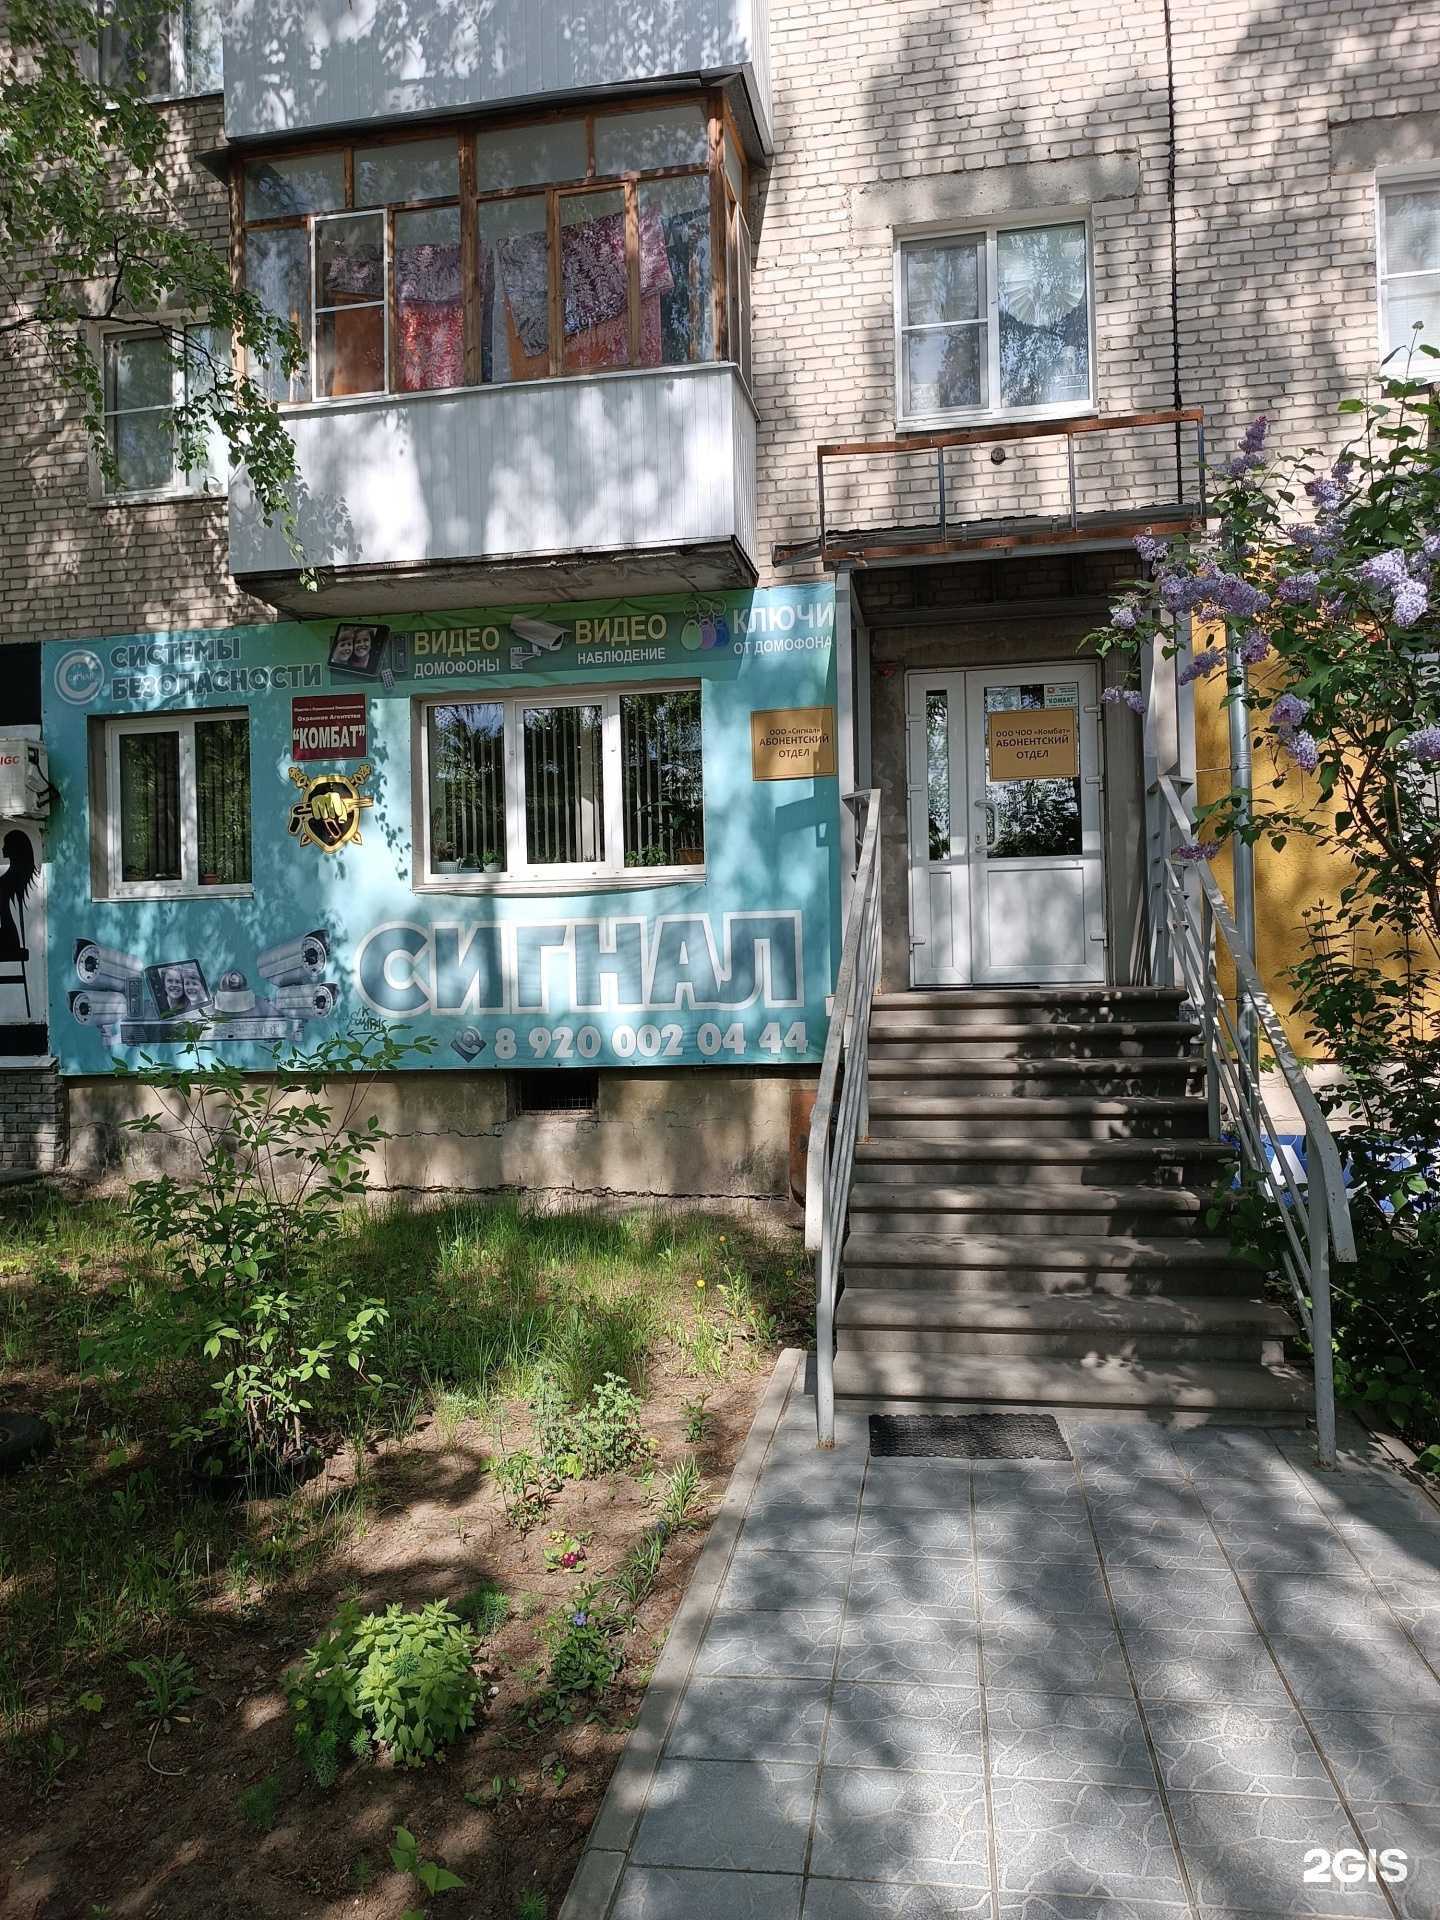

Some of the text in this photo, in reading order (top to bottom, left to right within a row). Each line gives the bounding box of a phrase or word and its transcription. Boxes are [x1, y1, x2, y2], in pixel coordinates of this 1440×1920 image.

[733, 602, 834, 634] КЛЮЧИ
[575, 614, 667, 647] ВИДЕО
[414, 626, 500, 657] ВИДЕО
[734, 636, 832, 656] ОТ ДОМОФОНА
[110, 637, 241, 669] СИСТЕМЫ
[577, 647, 667, 665] НАБЛЮДЕНИЕ
[414, 658, 500, 679] ДОМОФОНЫ
[111, 663, 322, 701] БЕЗОПАСНОСТИ
[760, 733, 830, 746] АБОНЕНТСКИЙ
[769, 728, 787, 736] ООО
[996, 730, 1014, 738] ООО
[1015, 728, 1033, 736] ЧОО
[996, 734, 1069, 748] АБОНЕНТСКИЙ
[778, 748, 810, 759] ОТДЕЛ
[1016, 750, 1049, 760] ОТДЕЛ
[353, 909, 806, 1017] СИГНАЛ
[494, 1021, 809, 1059] 8 920 002 04 44
